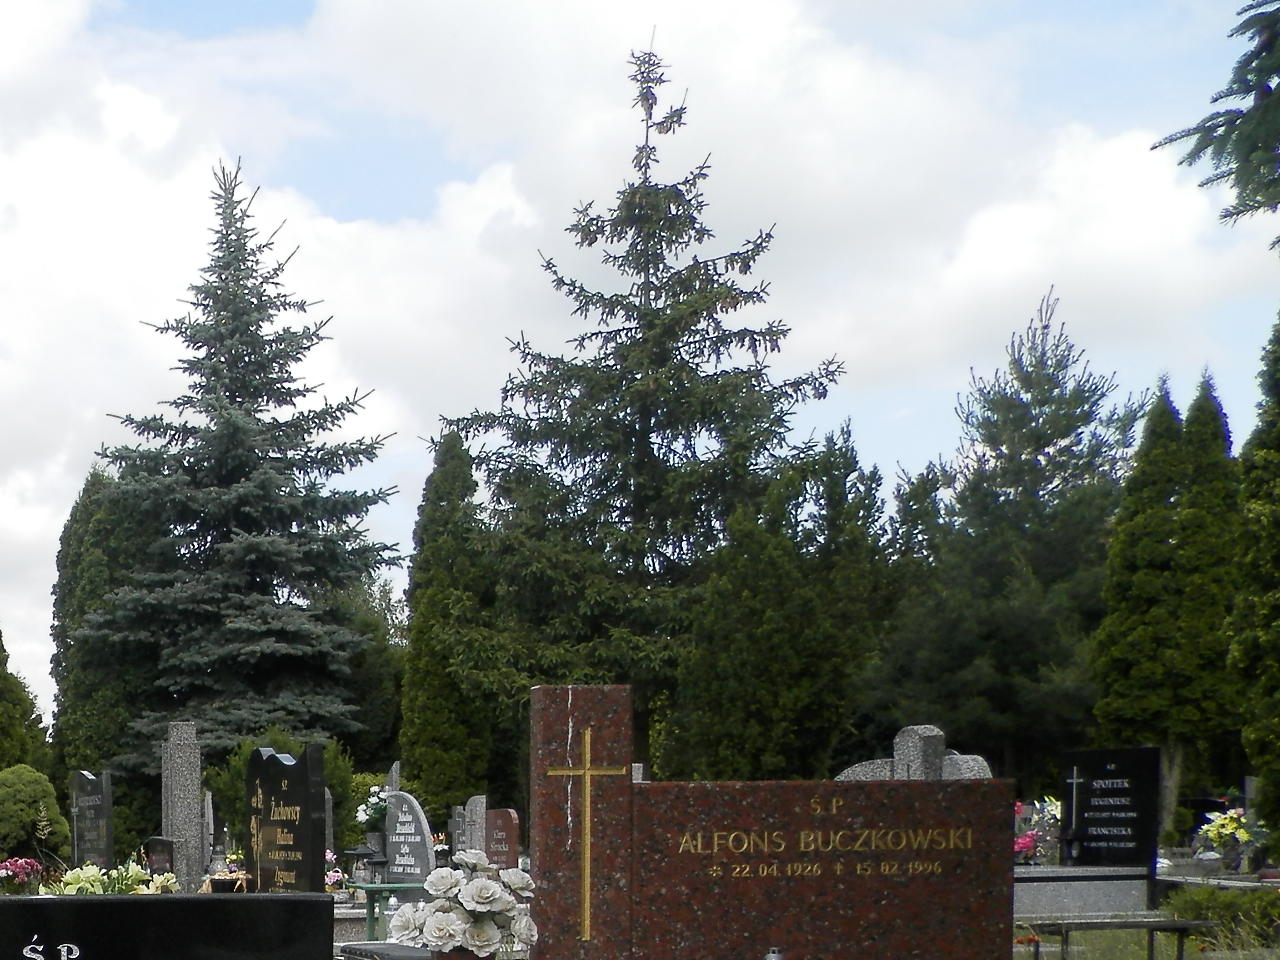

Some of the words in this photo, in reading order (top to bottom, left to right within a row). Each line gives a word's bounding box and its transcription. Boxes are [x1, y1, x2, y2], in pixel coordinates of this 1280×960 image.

[679, 831, 786, 854] ALFONS
[799, 827, 973, 851] BUCZKOWSKI
[786, 863, 821, 876] 1926
[908, 861, 942, 874] 1996
